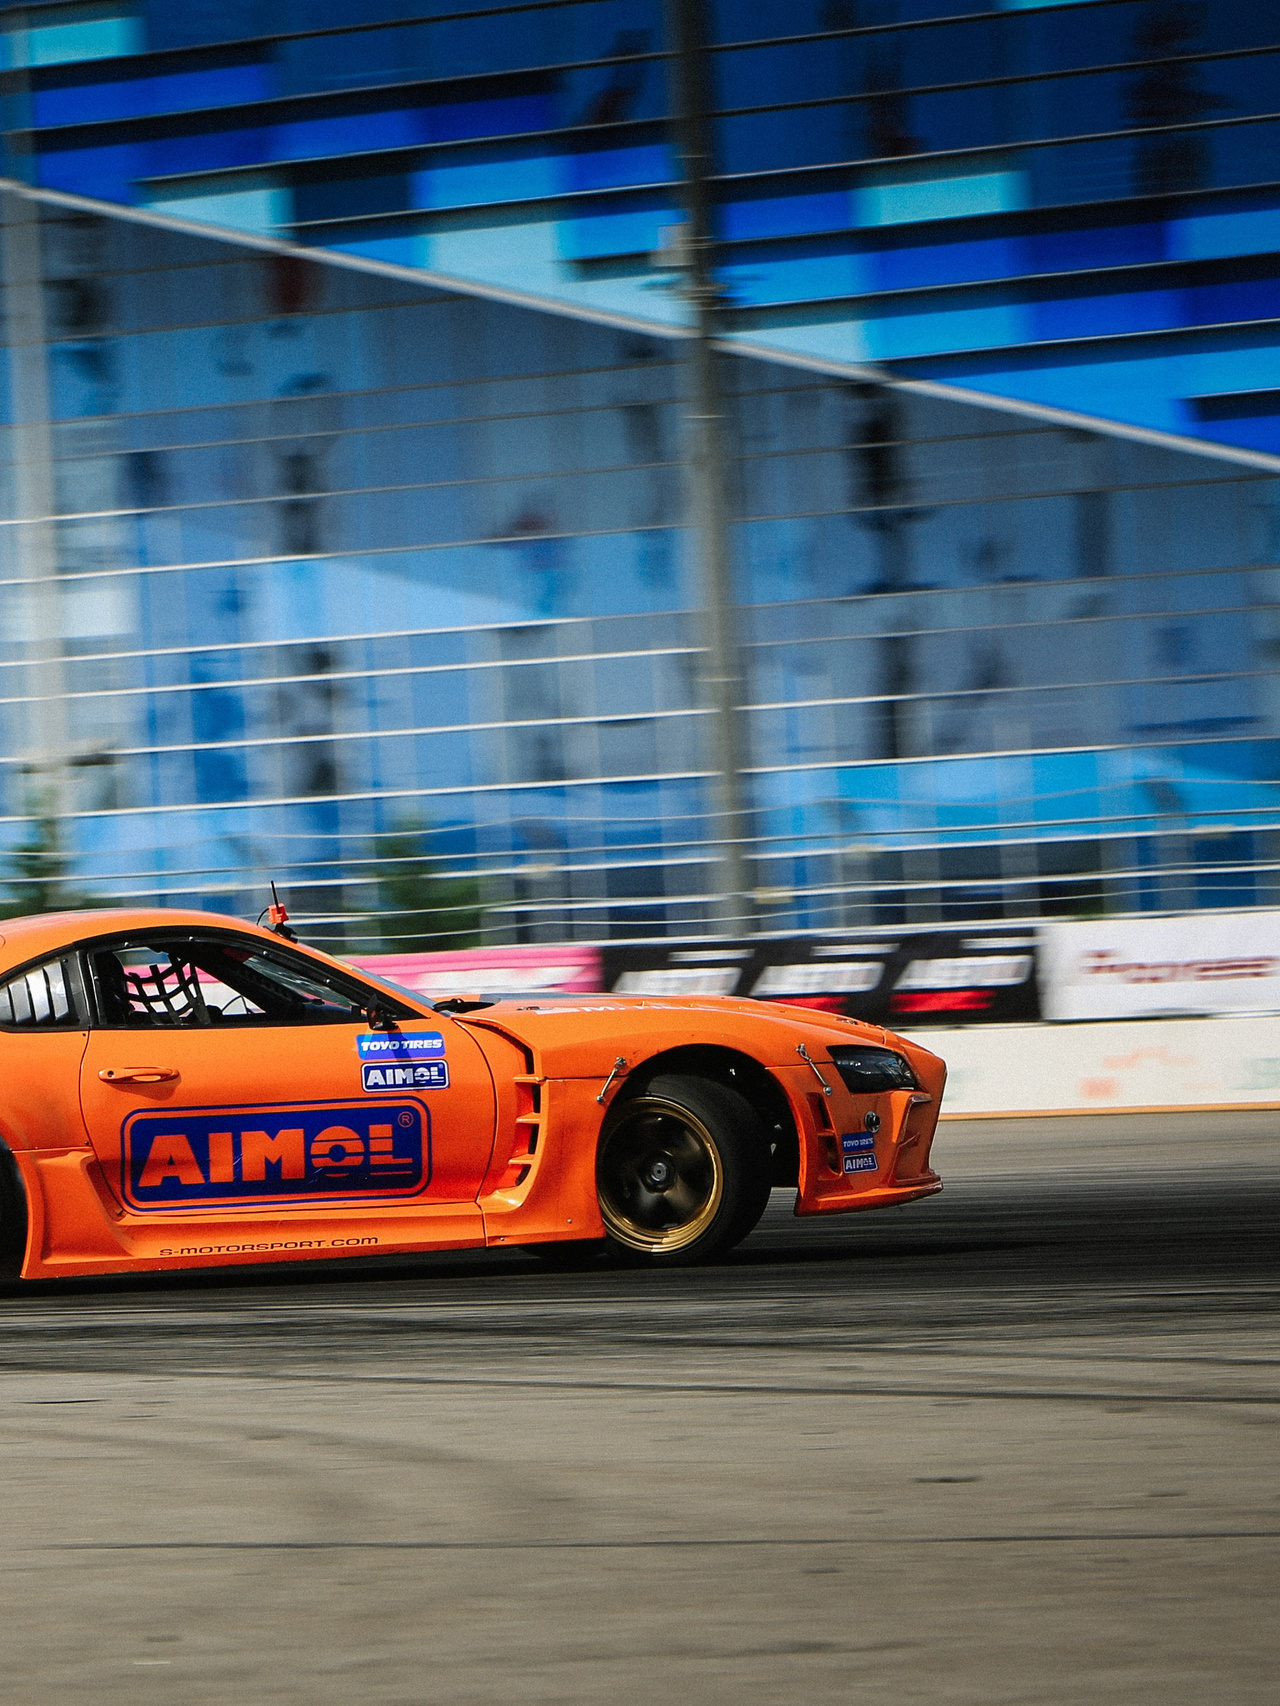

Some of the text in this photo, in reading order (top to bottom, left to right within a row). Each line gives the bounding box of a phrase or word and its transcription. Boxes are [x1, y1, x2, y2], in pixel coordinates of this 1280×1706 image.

[361, 1039, 443, 1051] TOYO TIRES
[366, 1066, 445, 1086] AIMOL
[843, 1140, 859, 1148] TOYO
[138, 1124, 414, 1188] AIMOL
